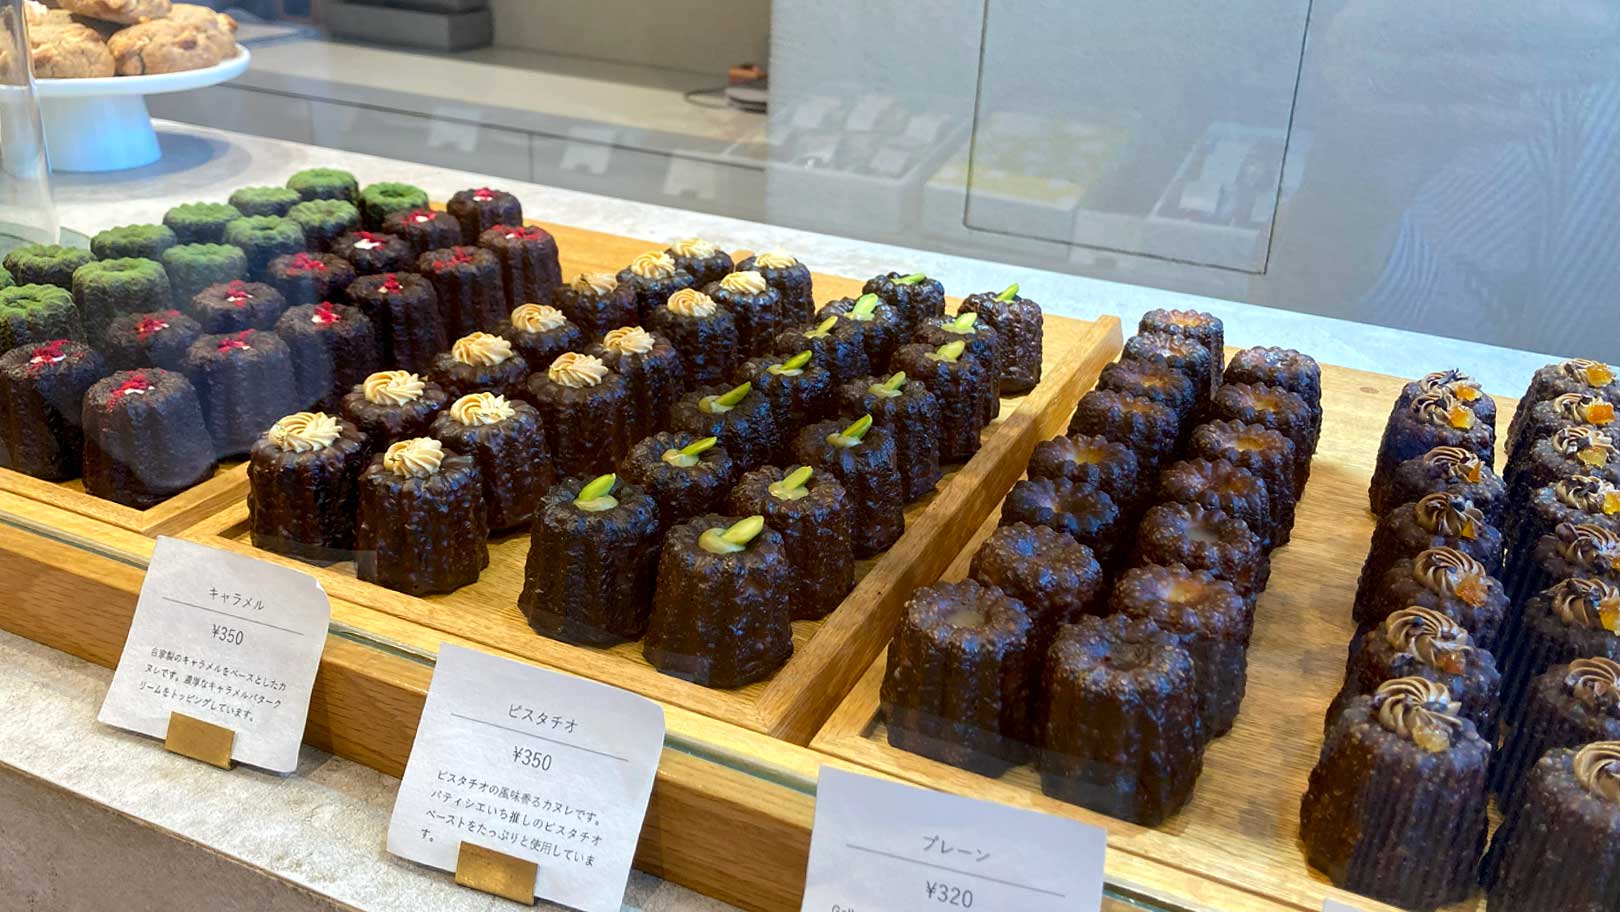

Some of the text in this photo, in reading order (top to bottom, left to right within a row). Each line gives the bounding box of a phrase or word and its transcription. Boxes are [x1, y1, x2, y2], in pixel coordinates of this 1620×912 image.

[209, 586, 264, 610] キャラメル
[211, 624, 244, 645] ¥350
[139, 681, 253, 721] リームをトッピングしています。
[509, 704, 578, 733] ピスタチオ
[513, 746, 552, 771] ¥350
[437, 769, 600, 826] ピスタチオの風味香るカヌレです。
[430, 789, 602, 846] パティシエいち推しのピスタチオ
[421, 828, 435, 842] す。
[426, 810, 594, 867] ペーストをたっぷりと使用していま
[922, 834, 991, 862] プレーン
[926, 880, 973, 909] ¥320
